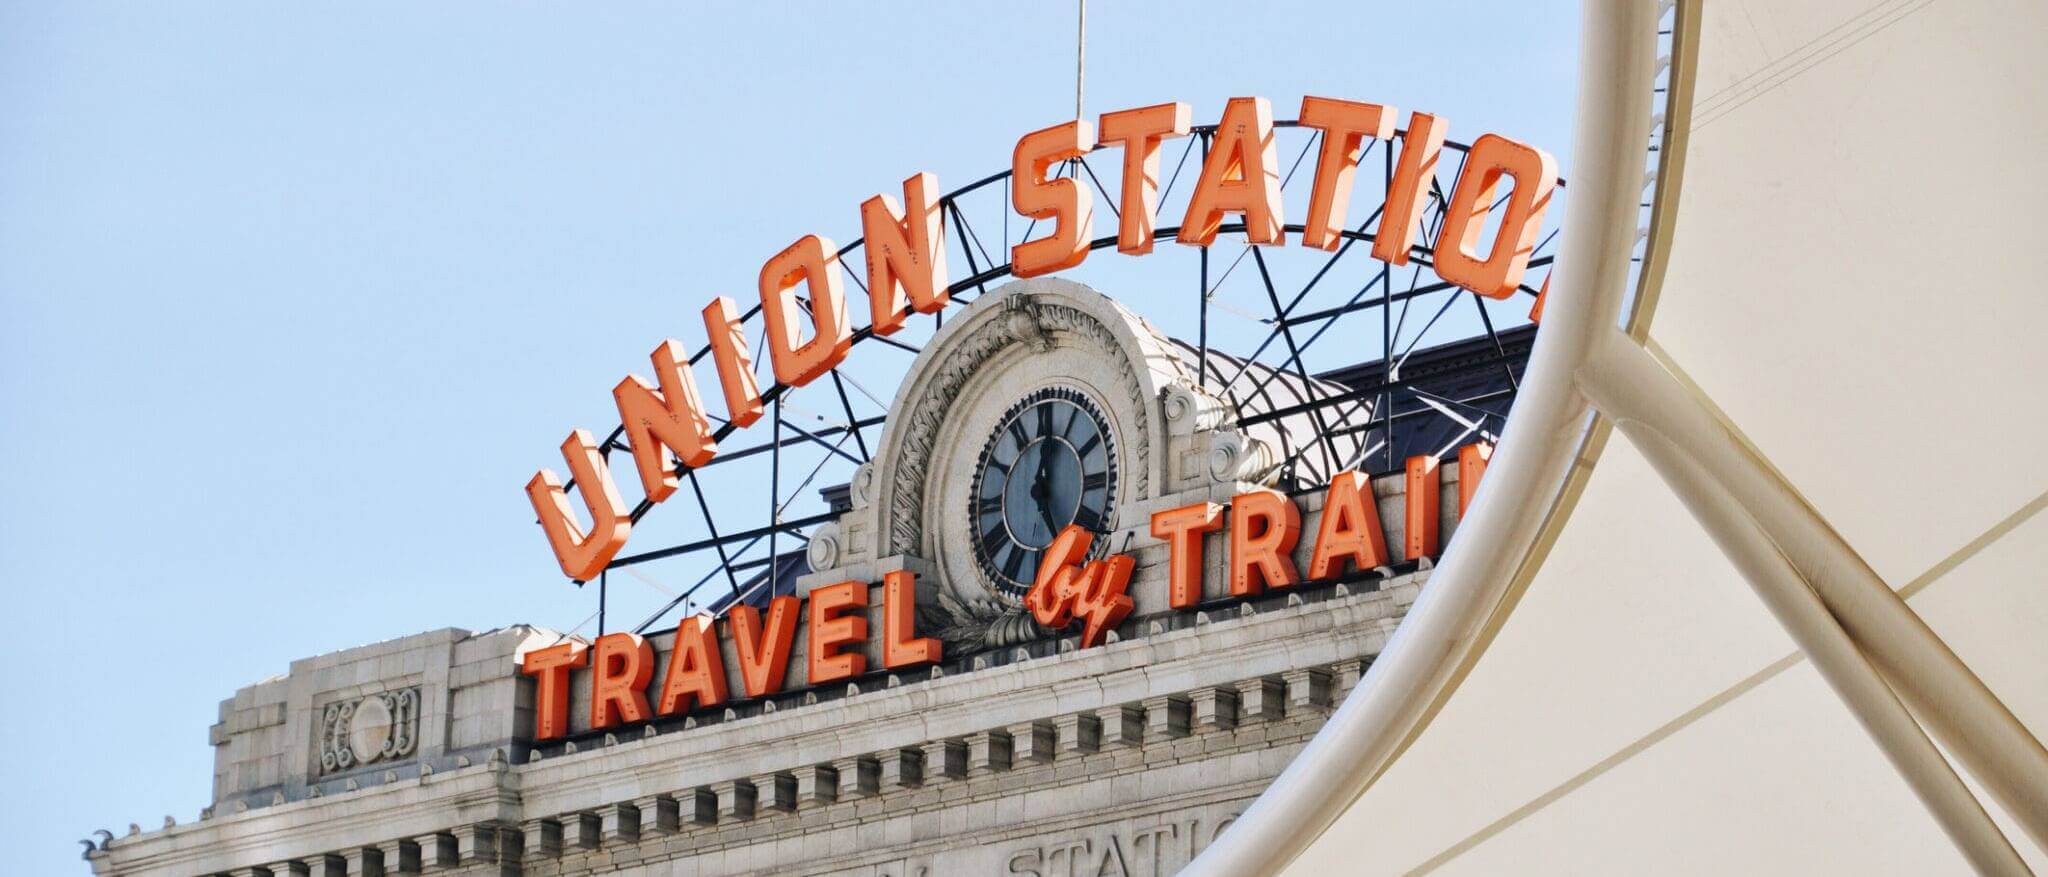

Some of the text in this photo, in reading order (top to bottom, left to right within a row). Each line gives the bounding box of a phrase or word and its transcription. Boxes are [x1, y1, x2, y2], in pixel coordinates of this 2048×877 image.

[525, 95, 1558, 582] UNION STATIO
[523, 570, 943, 740] TRAVEL
[1024, 523, 1136, 650] by
